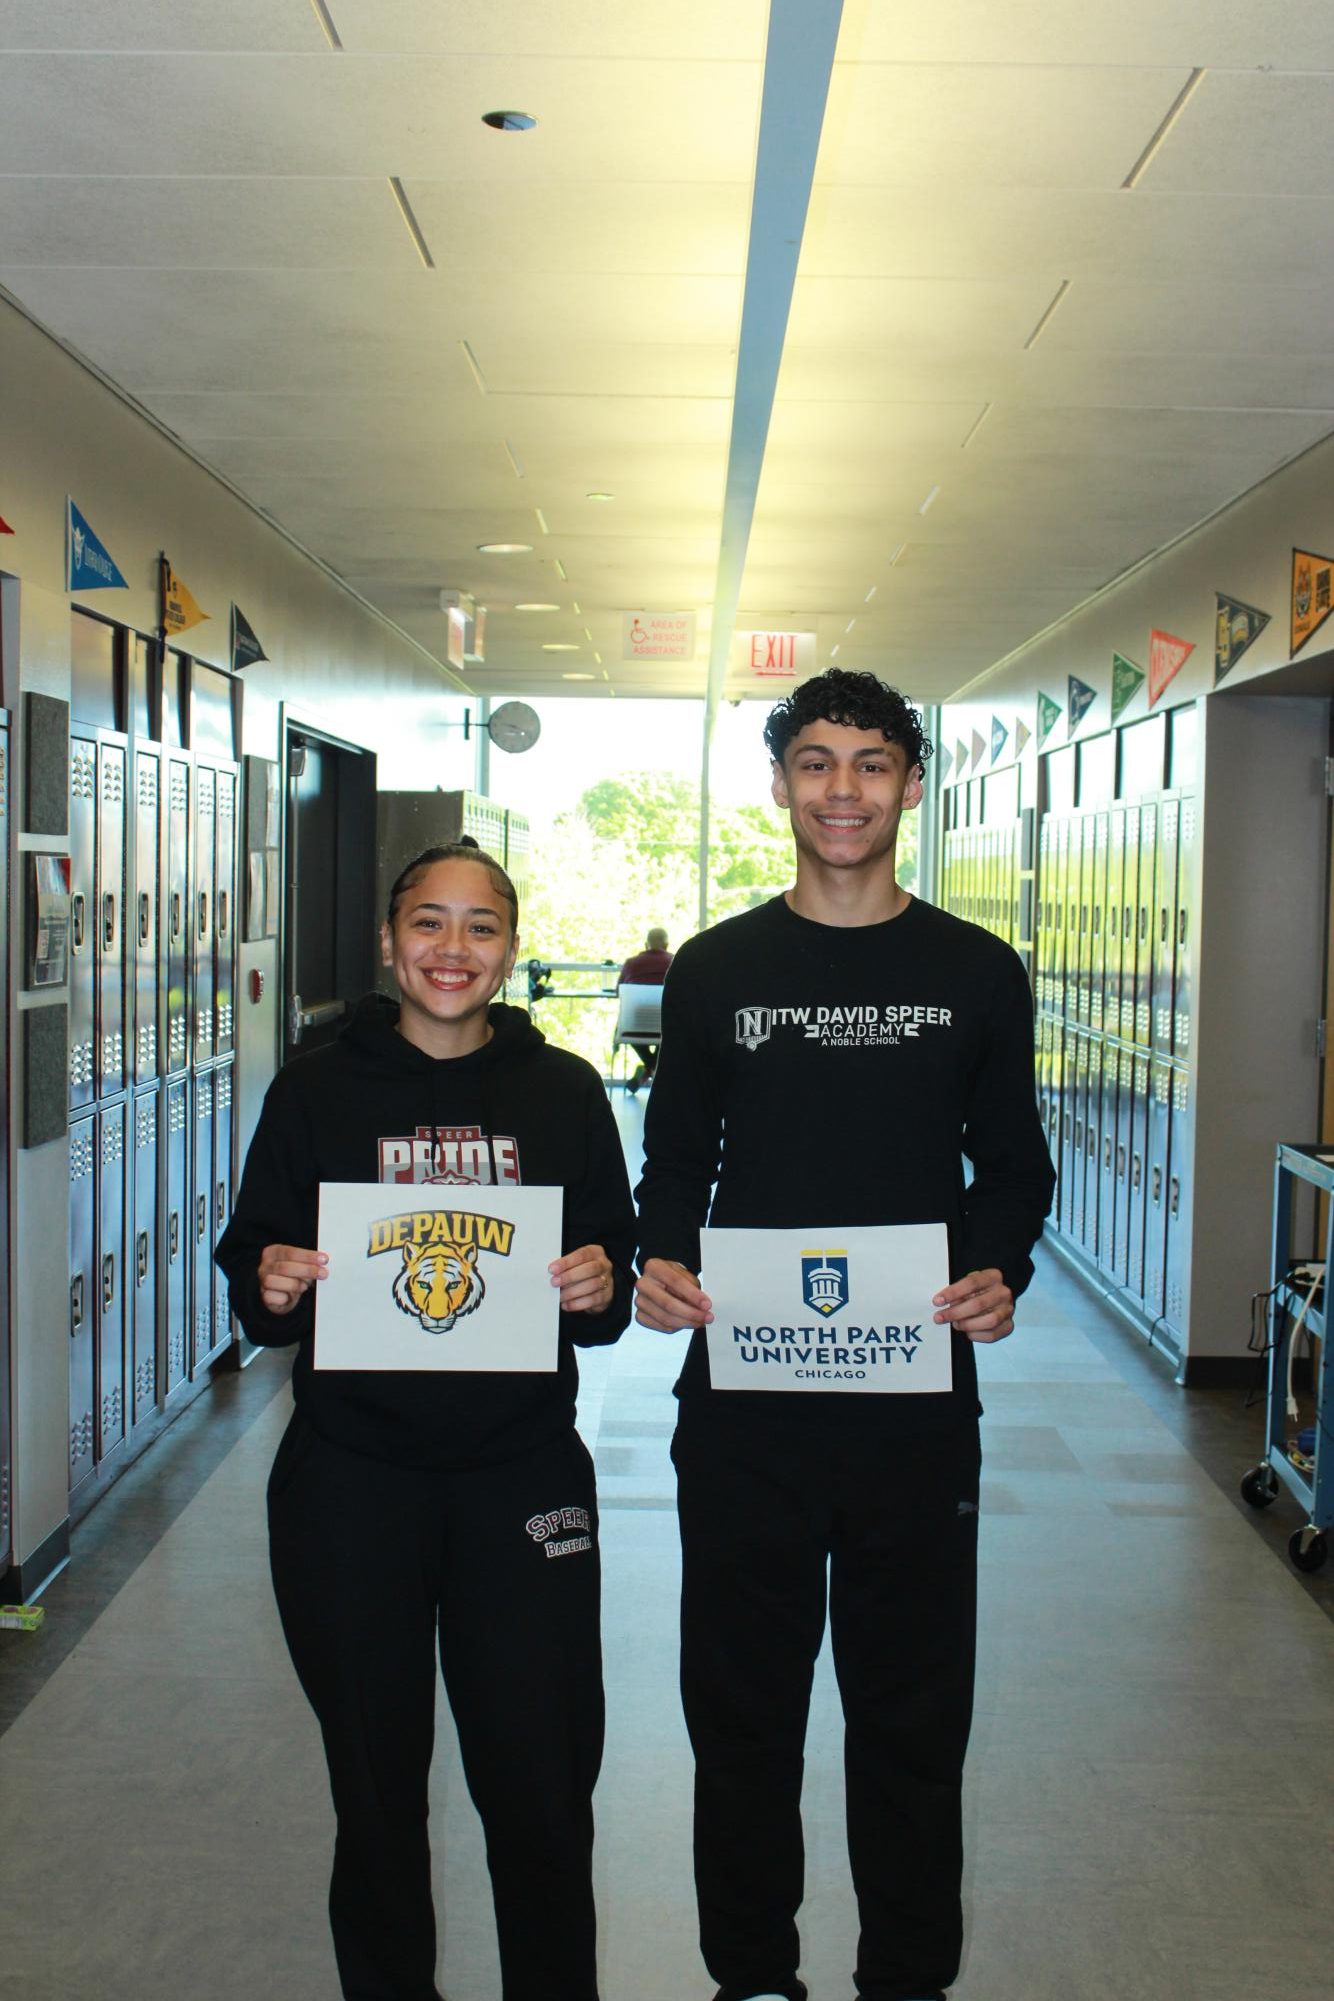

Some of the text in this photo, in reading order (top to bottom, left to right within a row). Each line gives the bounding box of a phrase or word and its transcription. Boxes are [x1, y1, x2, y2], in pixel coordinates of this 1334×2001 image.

[751, 634, 798, 668] EXIT
[743, 1010, 762, 1037] N
[772, 1005, 952, 1026] ITW DAVID SPEER
[820, 1023, 904, 1038] ACADEMY
[821, 1036, 900, 1046] A NOBLE SCHOOL
[382, 1141, 517, 1186] PRIDE
[368, 1211, 514, 1257] DEPAUW
[732, 1324, 923, 1344] NORTH PARK
[741, 1346, 918, 1365] UNIVERSITY
[795, 1369, 866, 1379] CHICAGO
